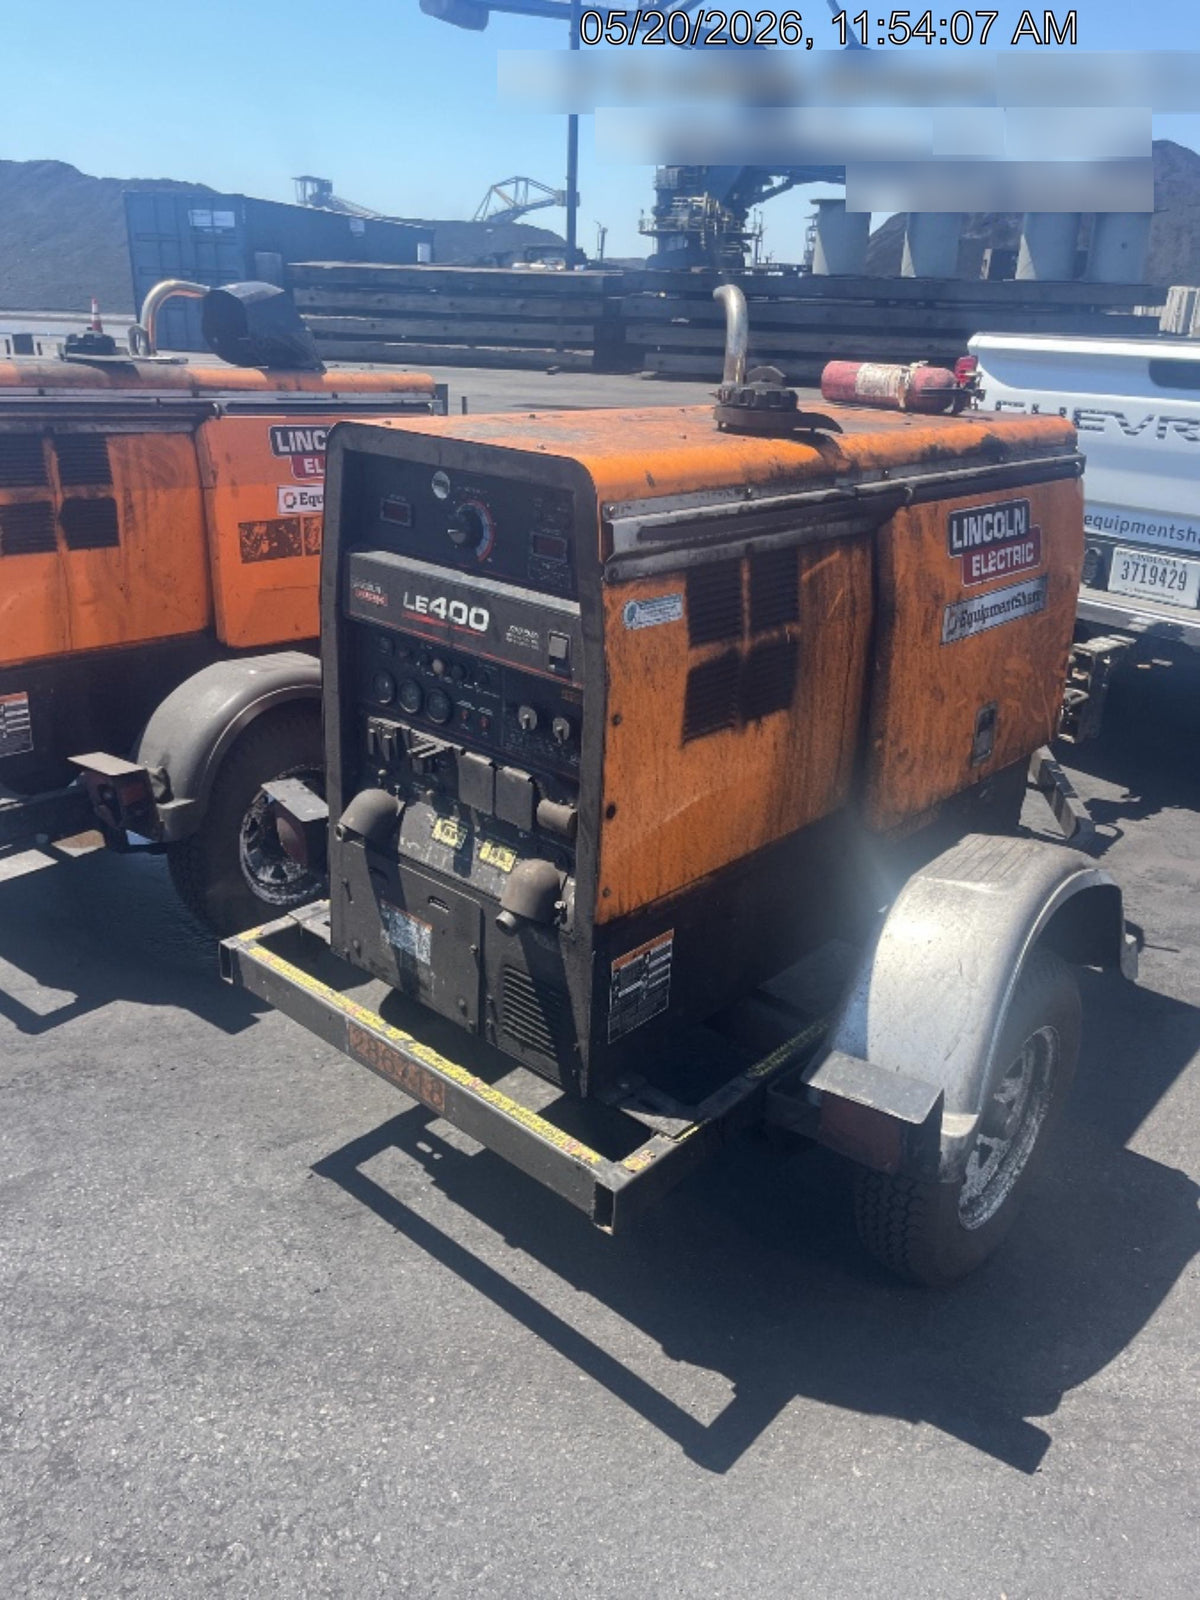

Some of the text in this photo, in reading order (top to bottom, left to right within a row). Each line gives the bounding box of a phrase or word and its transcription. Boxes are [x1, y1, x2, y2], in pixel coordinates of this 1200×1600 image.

[952, 506, 1026, 549] LINCOLN
[1084, 514, 1200, 544] equipmentsh
[972, 541, 1035, 577] ELECTRIC
[1121, 560, 1188, 591] 3719429
[403, 591, 490, 632] LE400
